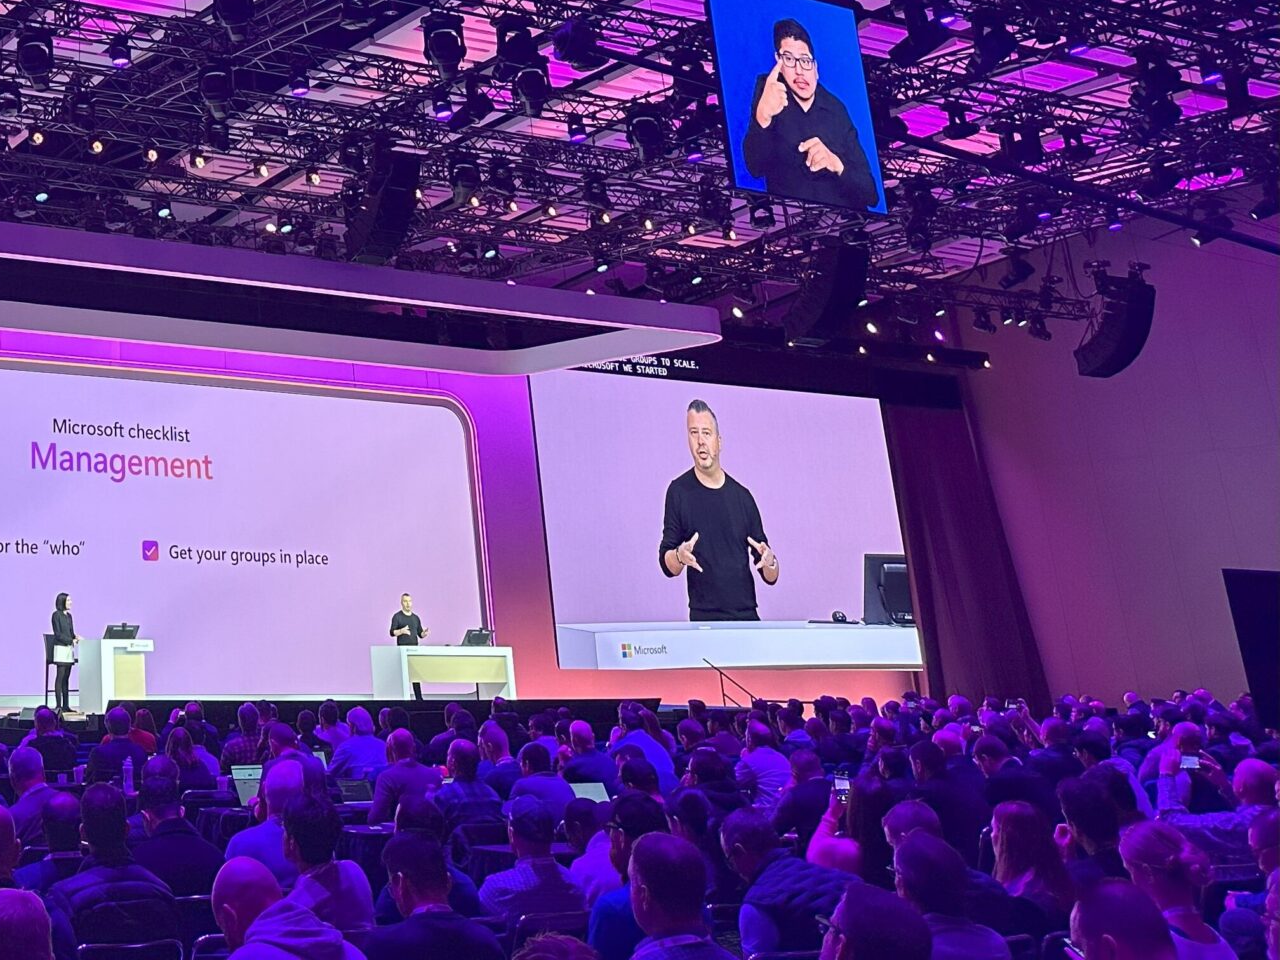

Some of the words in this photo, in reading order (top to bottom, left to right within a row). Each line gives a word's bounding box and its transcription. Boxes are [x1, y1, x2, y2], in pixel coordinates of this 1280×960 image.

[622, 364, 632, 372] WE
[636, 366, 668, 376] STARTED
[660, 358, 670, 366] TO
[673, 360, 699, 369] SCALE.
[52, 418, 124, 438] Microsoft
[128, 424, 190, 442] checklist
[30, 441, 214, 483] Management
[15, 539, 38, 554] the
[169, 545, 192, 559] Get
[197, 549, 227, 564] your
[230, 551, 276, 566] groups
[280, 549, 291, 563] in
[296, 550, 328, 568] place
[634, 644, 668, 655] Microsoft
